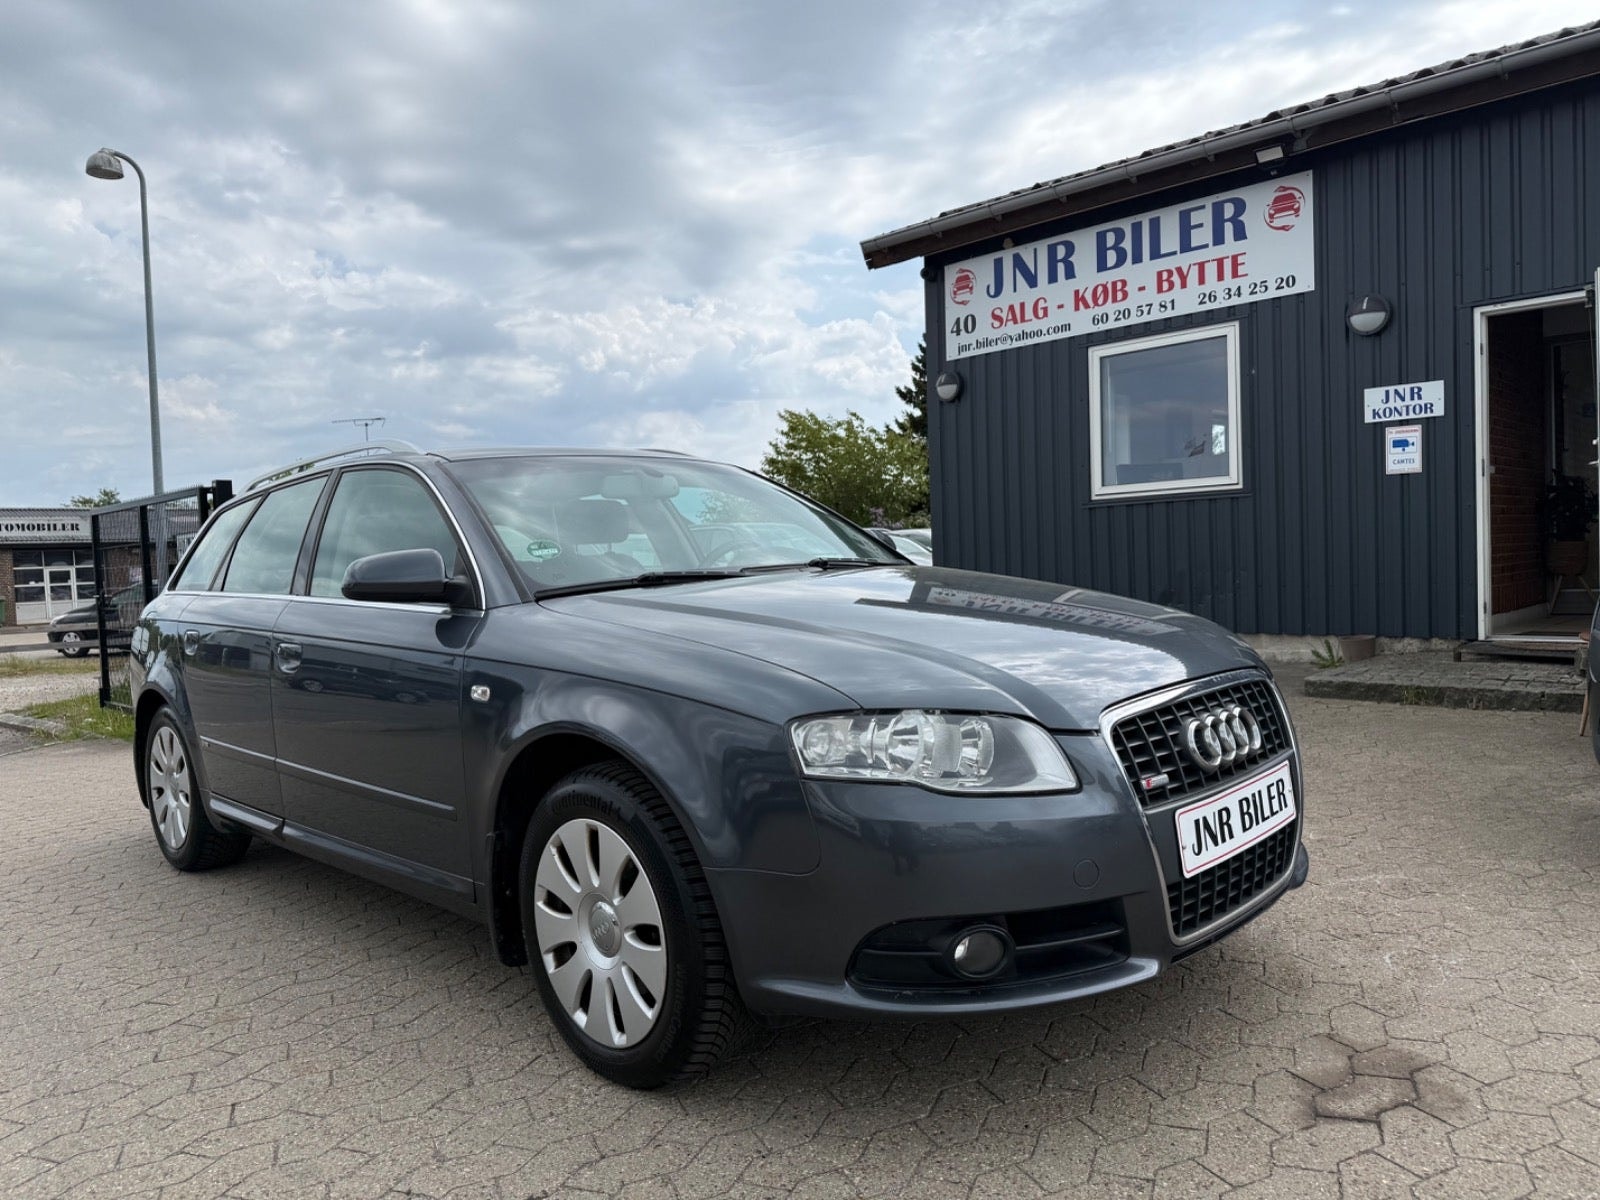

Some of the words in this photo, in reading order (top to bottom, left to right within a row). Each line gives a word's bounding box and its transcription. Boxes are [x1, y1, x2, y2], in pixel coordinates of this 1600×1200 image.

[986, 239, 1077, 299] JNR
[1096, 196, 1248, 273] BILER
[990, 296, 1049, 330] SALG
[1073, 279, 1129, 312] KØB
[1156, 252, 1249, 294] BYTTE
[1198, 289, 1218, 306] 26
[1222, 285, 1242, 301] 34
[1248, 280, 1269, 296] 25
[1274, 274, 1296, 291] 20
[950, 313, 977, 337] 40
[1092, 311, 1109, 326] 60
[1113, 307, 1132, 322] 20
[1135, 303, 1154, 317] 57
[1158, 298, 1176, 313] 81
[957, 322, 1072, 356] jnr.biler@yahoo.com
[1372, 402, 1434, 419] KONTOR
[1381, 386, 1422, 404] JNR
[1191, 806, 1235, 857] JNR
[1238, 778, 1288, 833] BILER
